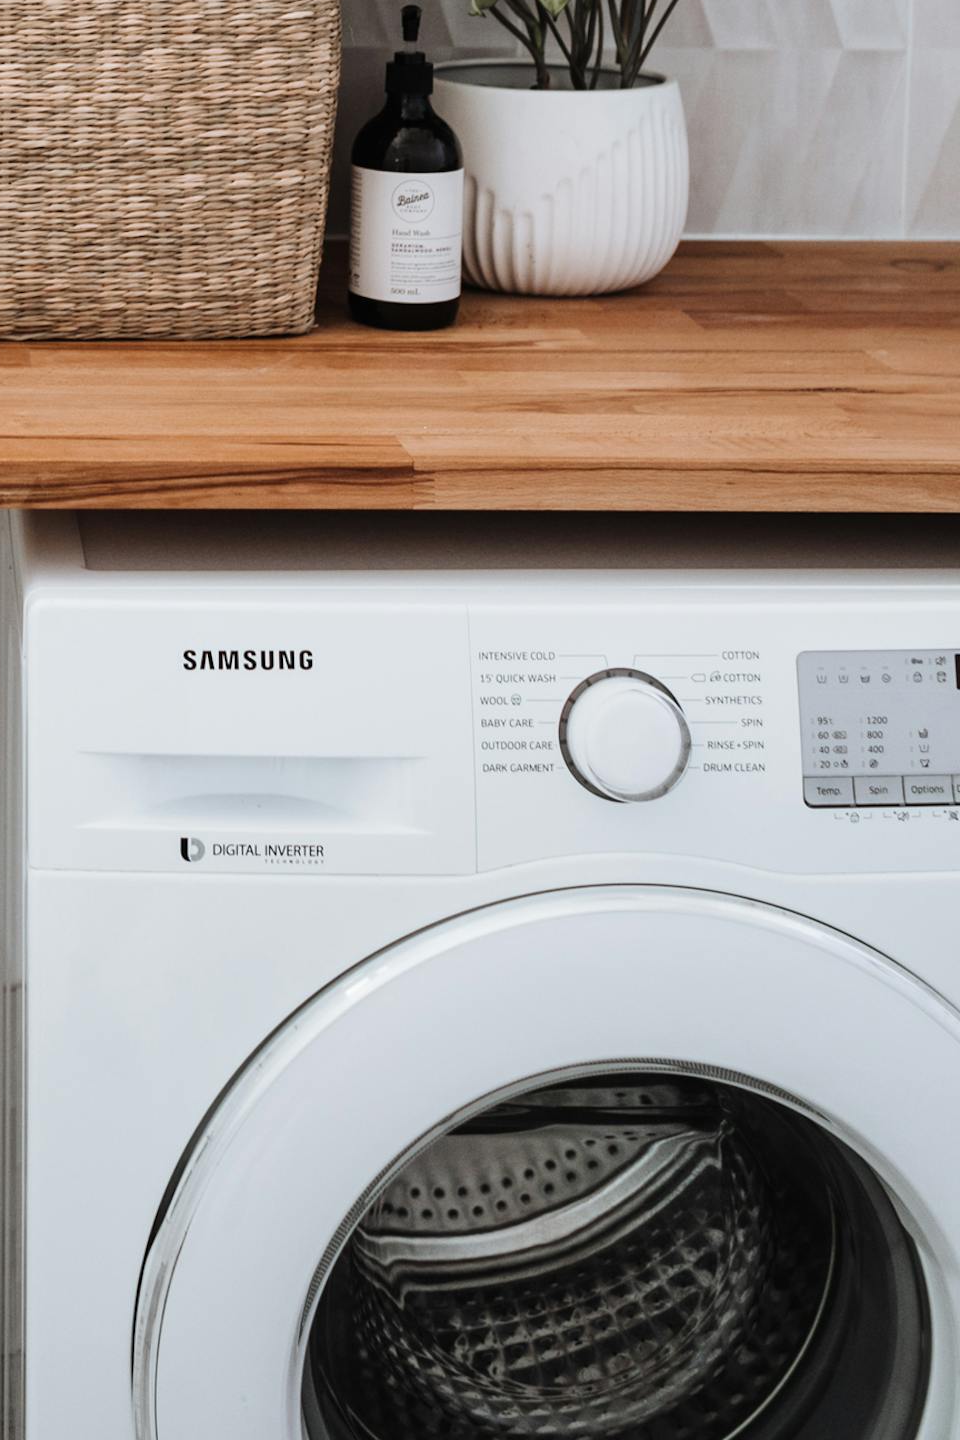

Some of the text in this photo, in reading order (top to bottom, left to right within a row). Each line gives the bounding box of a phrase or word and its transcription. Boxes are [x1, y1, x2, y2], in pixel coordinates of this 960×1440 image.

[478, 651, 556, 661] INTENSIVE COLD
[721, 650, 760, 660] COTTON
[183, 650, 313, 670] SAMSUNG
[496, 673, 525, 684] QUICK
[527, 674, 556, 683] WASH
[723, 673, 761, 682] COTTON
[479, 696, 509, 706] WOOL
[705, 695, 763, 705] SYNTHETICS
[481, 718, 534, 728] BABY CARE
[741, 718, 763, 727] SPIN
[866, 716, 888, 725] 1200
[817, 731, 829, 740] 60
[866, 730, 884, 739] 800
[481, 741, 553, 750] OUTDOOR CARE
[707, 741, 735, 750] RINSE
[743, 741, 765, 750] SPIN
[819, 746, 830, 754] 40
[867, 745, 884, 753] 400
[482, 763, 554, 772] DARK GARMENT
[703, 763, 766, 772] DRUM CLEAN
[820, 760, 831, 769] 20
[869, 785, 889, 796] Spin
[911, 784, 944, 795] Options
[212, 843, 324, 857] DIGITAL INVERTER
